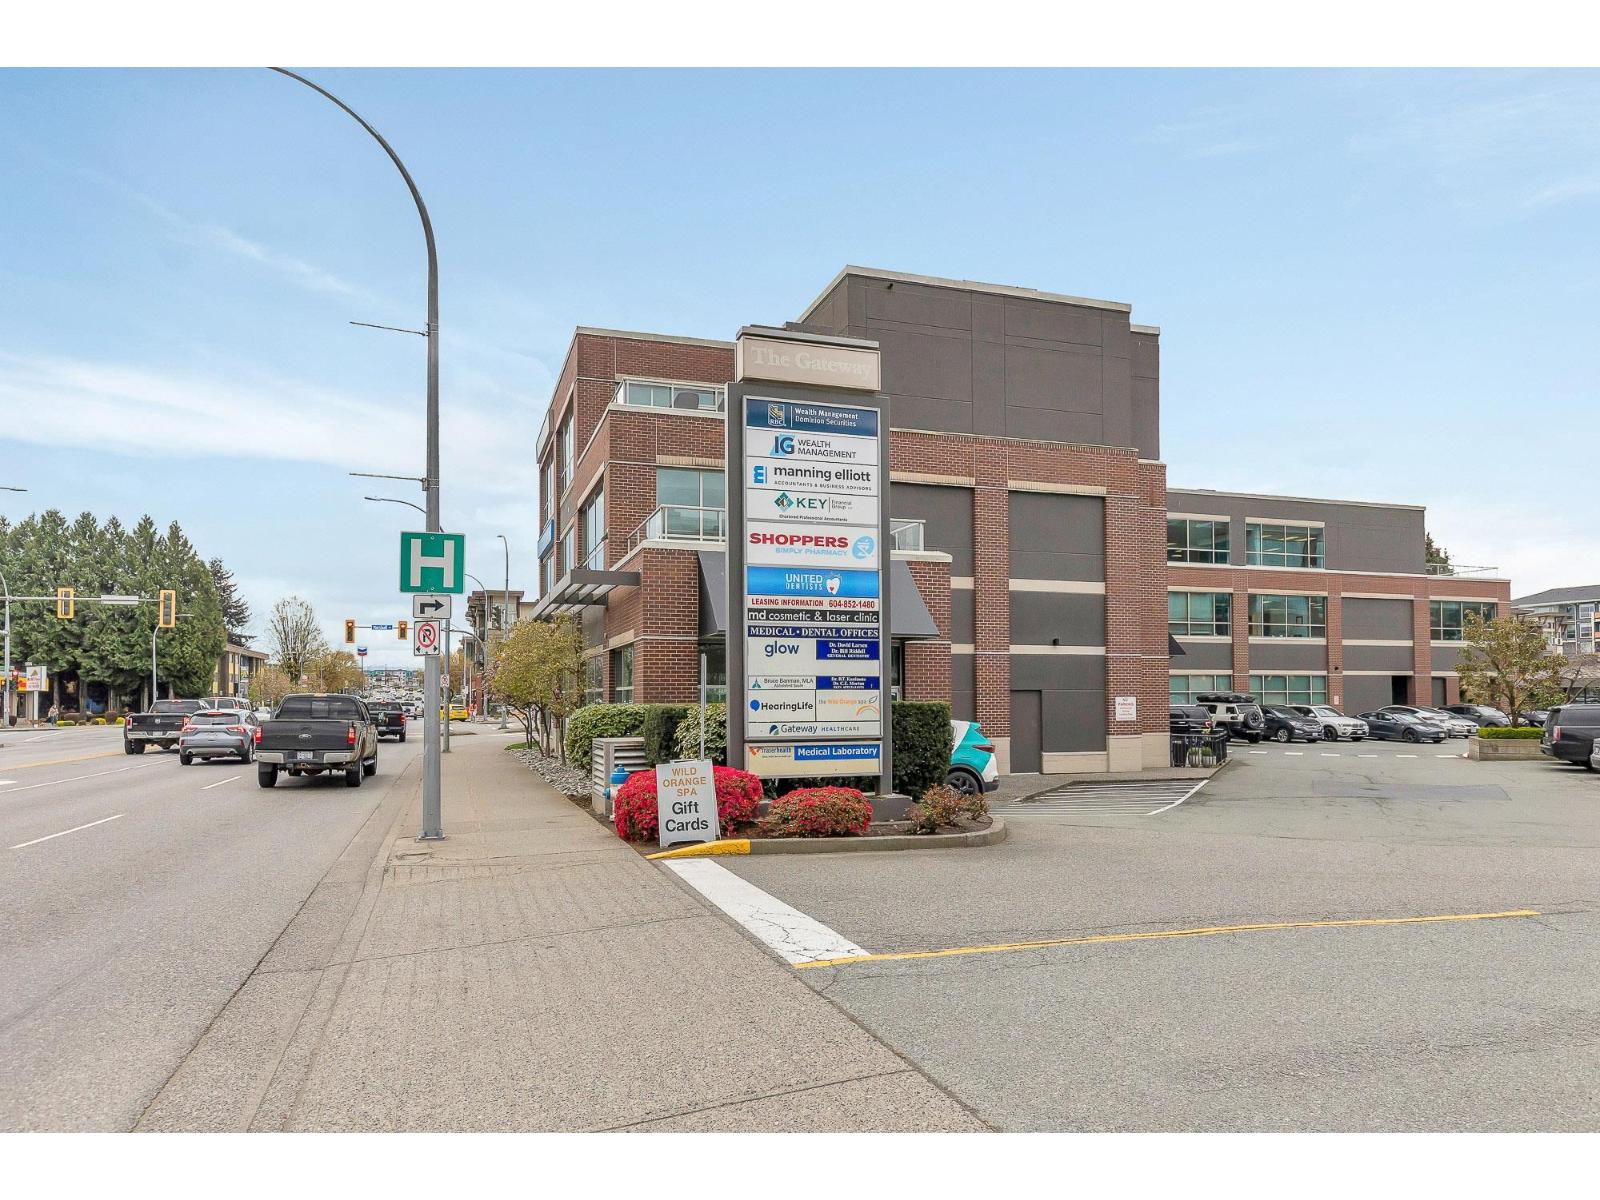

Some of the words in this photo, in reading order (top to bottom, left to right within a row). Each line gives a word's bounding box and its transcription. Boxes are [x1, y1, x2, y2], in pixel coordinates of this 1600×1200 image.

[751, 347, 790, 366] The
[795, 352, 873, 380] Gateway
[795, 408, 817, 416] Wealth
[818, 409, 859, 420] Management
[795, 415, 825, 424] Dominion
[826, 418, 857, 427] Securities
[774, 436, 795, 454] IG
[798, 439, 831, 448] WEALTH
[798, 448, 857, 458] MANAGEMENT
[774, 467, 832, 481] manning
[835, 469, 871, 481] elliott
[796, 498, 828, 509] KEY
[750, 532, 849, 548] SHOPPERS
[805, 548, 848, 556] PHARMACY
[410, 538, 455, 588] H
[785, 573, 823, 583] UNITED
[781, 599, 824, 607] INFORMATION
[829, 600, 875, 609] 604-852-1480
[748, 610, 766, 620] md
[768, 611, 811, 621] cosmetic
[814, 611, 822, 621] &
[827, 611, 850, 621] laser
[854, 612, 878, 623] clinic
[750, 626, 796, 636] MEDICAL
[801, 627, 839, 636] DENTAL
[840, 628, 879, 637] OFFICES
[764, 640, 800, 657] glow
[761, 702, 814, 711] HearingLife
[781, 725, 818, 734] Gateway
[798, 748, 830, 756] Medical
[832, 747, 878, 757] Laboratory
[672, 767, 697, 776] WILD
[663, 777, 707, 788] ORANGE
[676, 788, 698, 797] SPA
[672, 801, 699, 815] Gift
[665, 817, 709, 832] Cards
